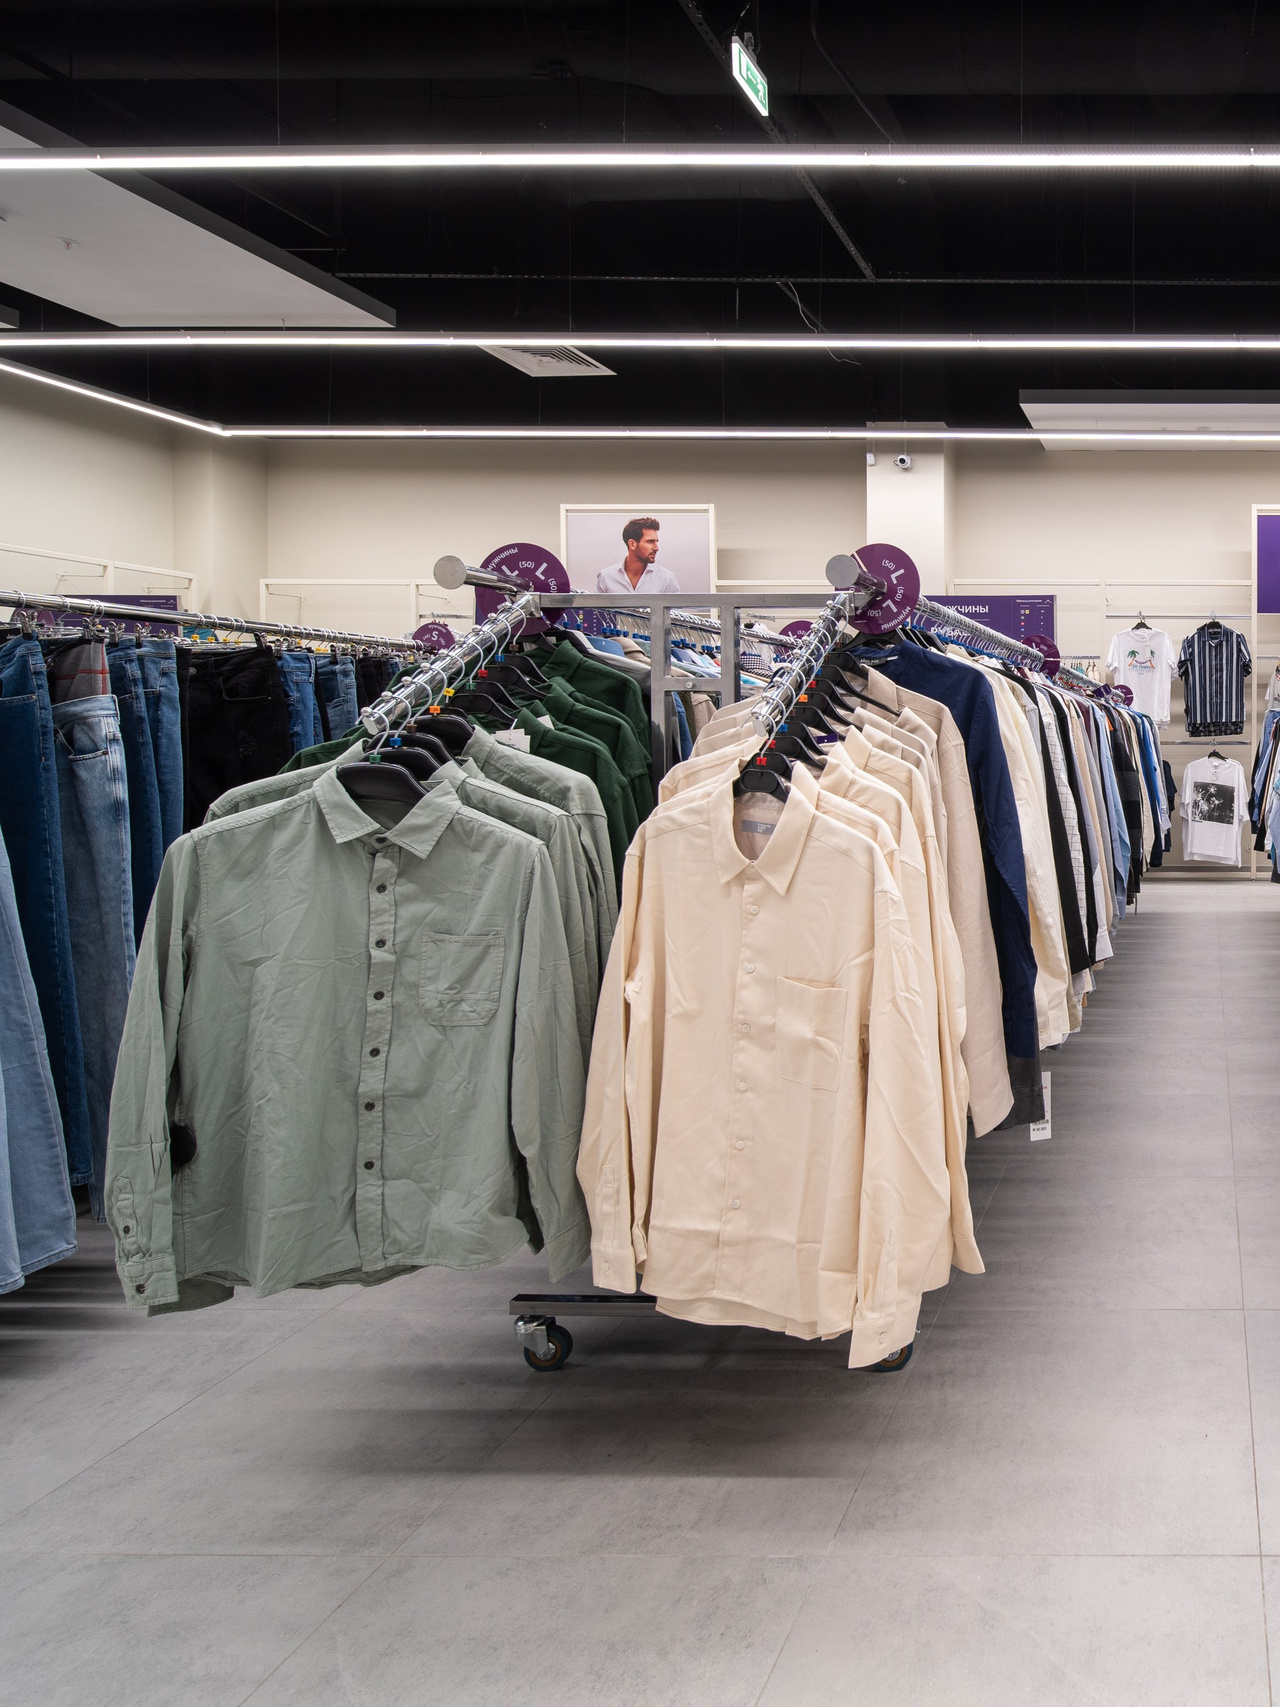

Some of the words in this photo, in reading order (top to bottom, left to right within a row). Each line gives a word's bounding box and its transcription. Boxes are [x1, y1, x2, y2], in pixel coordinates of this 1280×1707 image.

[519, 561, 535, 569] (50)
[535, 562, 548, 580] L
[882, 559, 896, 570] (50)
[890, 568, 905, 584] L
[894, 586, 904, 602] (50)
[882, 599, 898, 613] L
[431, 631, 438, 641] S
